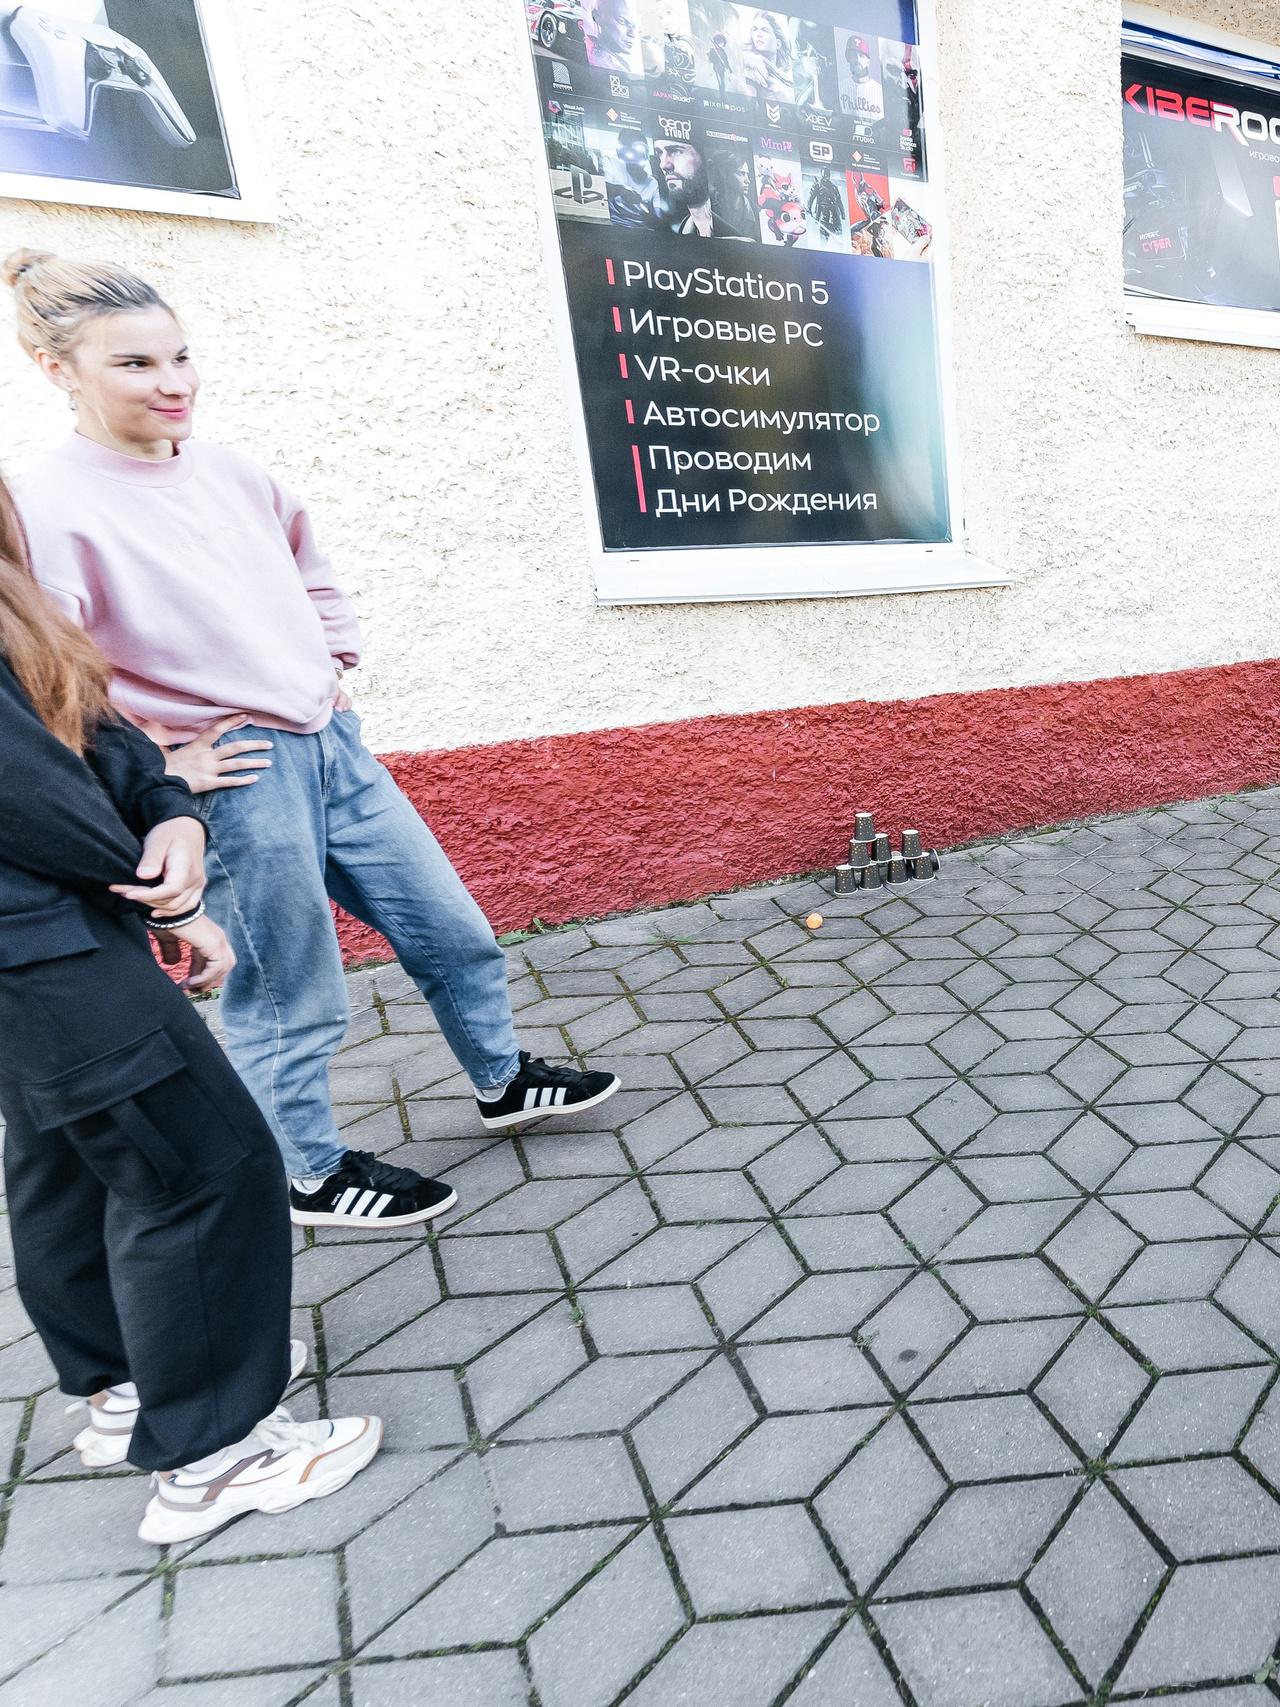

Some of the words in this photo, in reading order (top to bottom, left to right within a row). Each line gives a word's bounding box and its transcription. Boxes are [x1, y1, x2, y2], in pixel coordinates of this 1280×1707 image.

[664, 127, 690, 140] STUDIO
[623, 260, 803, 303] PlayStation
[811, 280, 829, 305] 5
[629, 308, 777, 344] Игровые
[783, 320, 824, 347] PC
[634, 354, 771, 386] VR-очки
[643, 400, 881, 436] Автосимулятор
[648, 444, 812, 475] Проводим
[655, 489, 721, 518] Дни
[728, 488, 878, 515] Рождения
